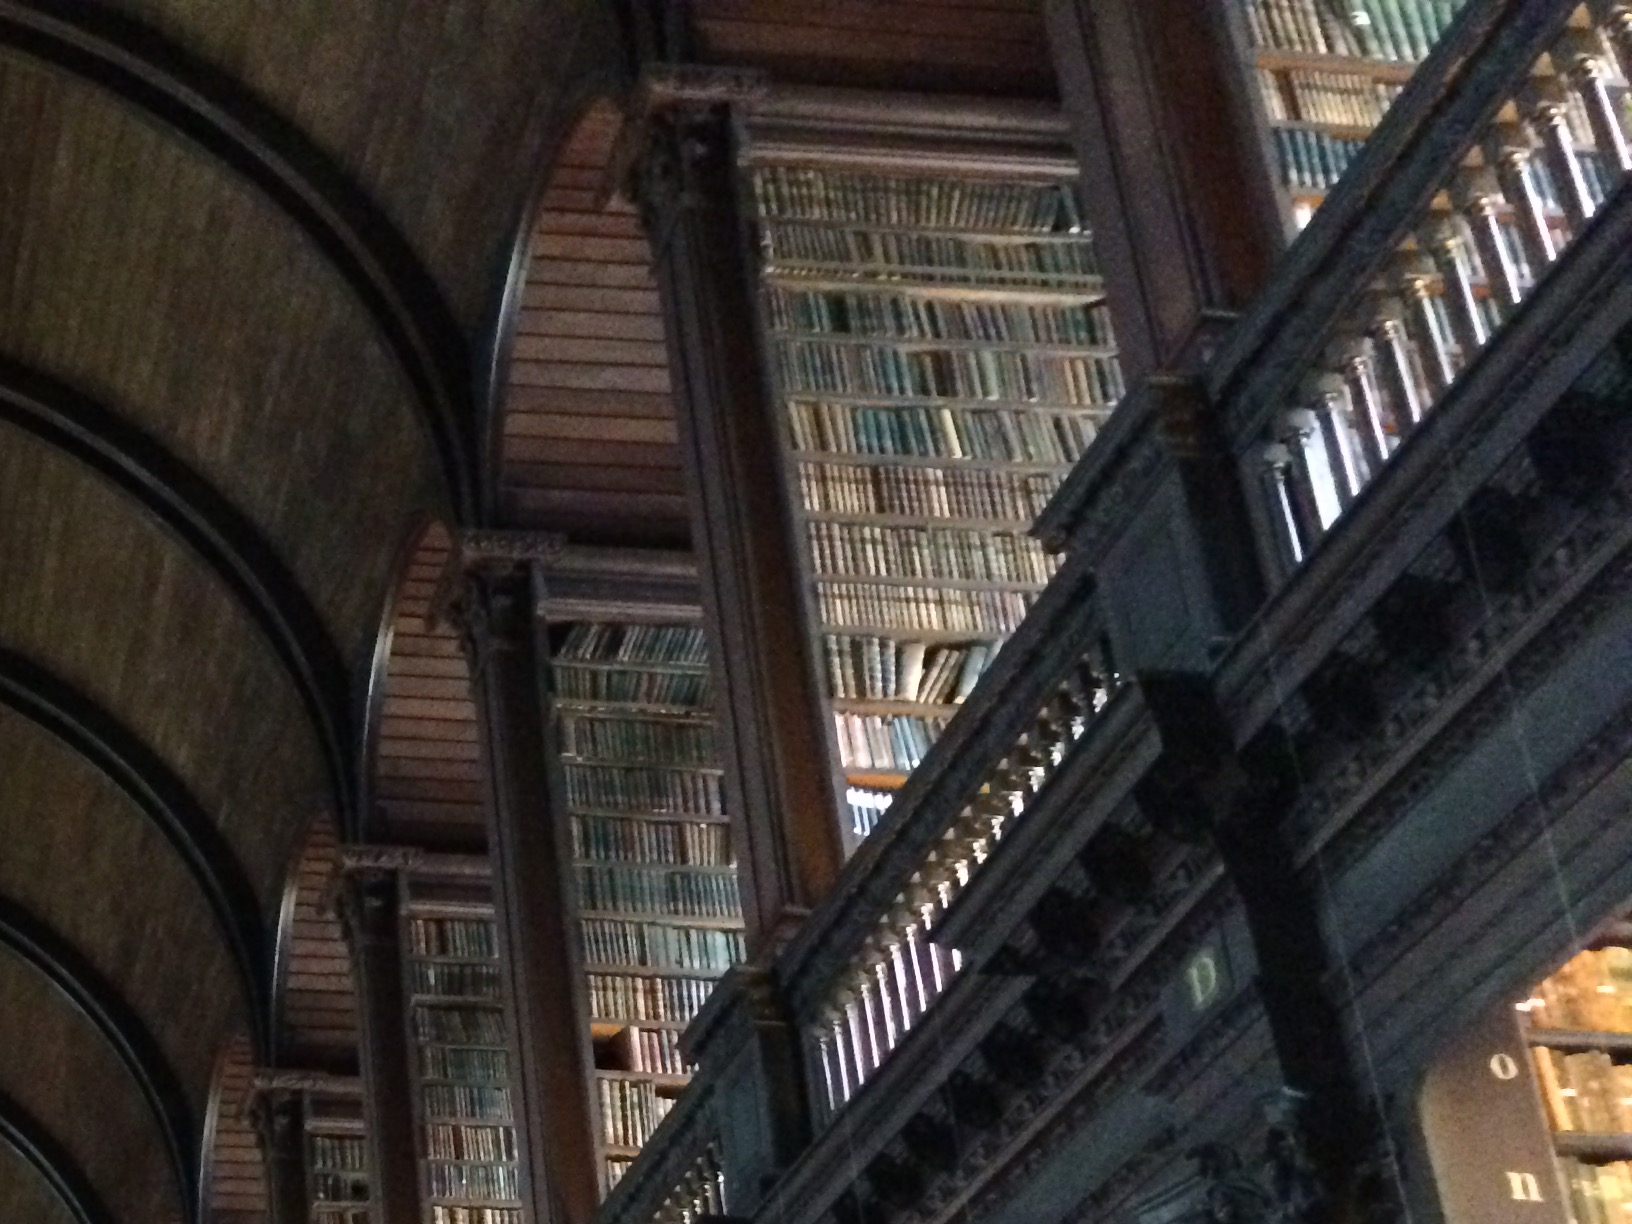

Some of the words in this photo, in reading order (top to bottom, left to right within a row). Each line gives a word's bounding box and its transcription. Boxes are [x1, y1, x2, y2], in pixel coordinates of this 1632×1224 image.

[1186, 956, 1217, 1006] D
[1489, 1053, 1519, 1080] o
[1506, 1171, 1544, 1202] n
